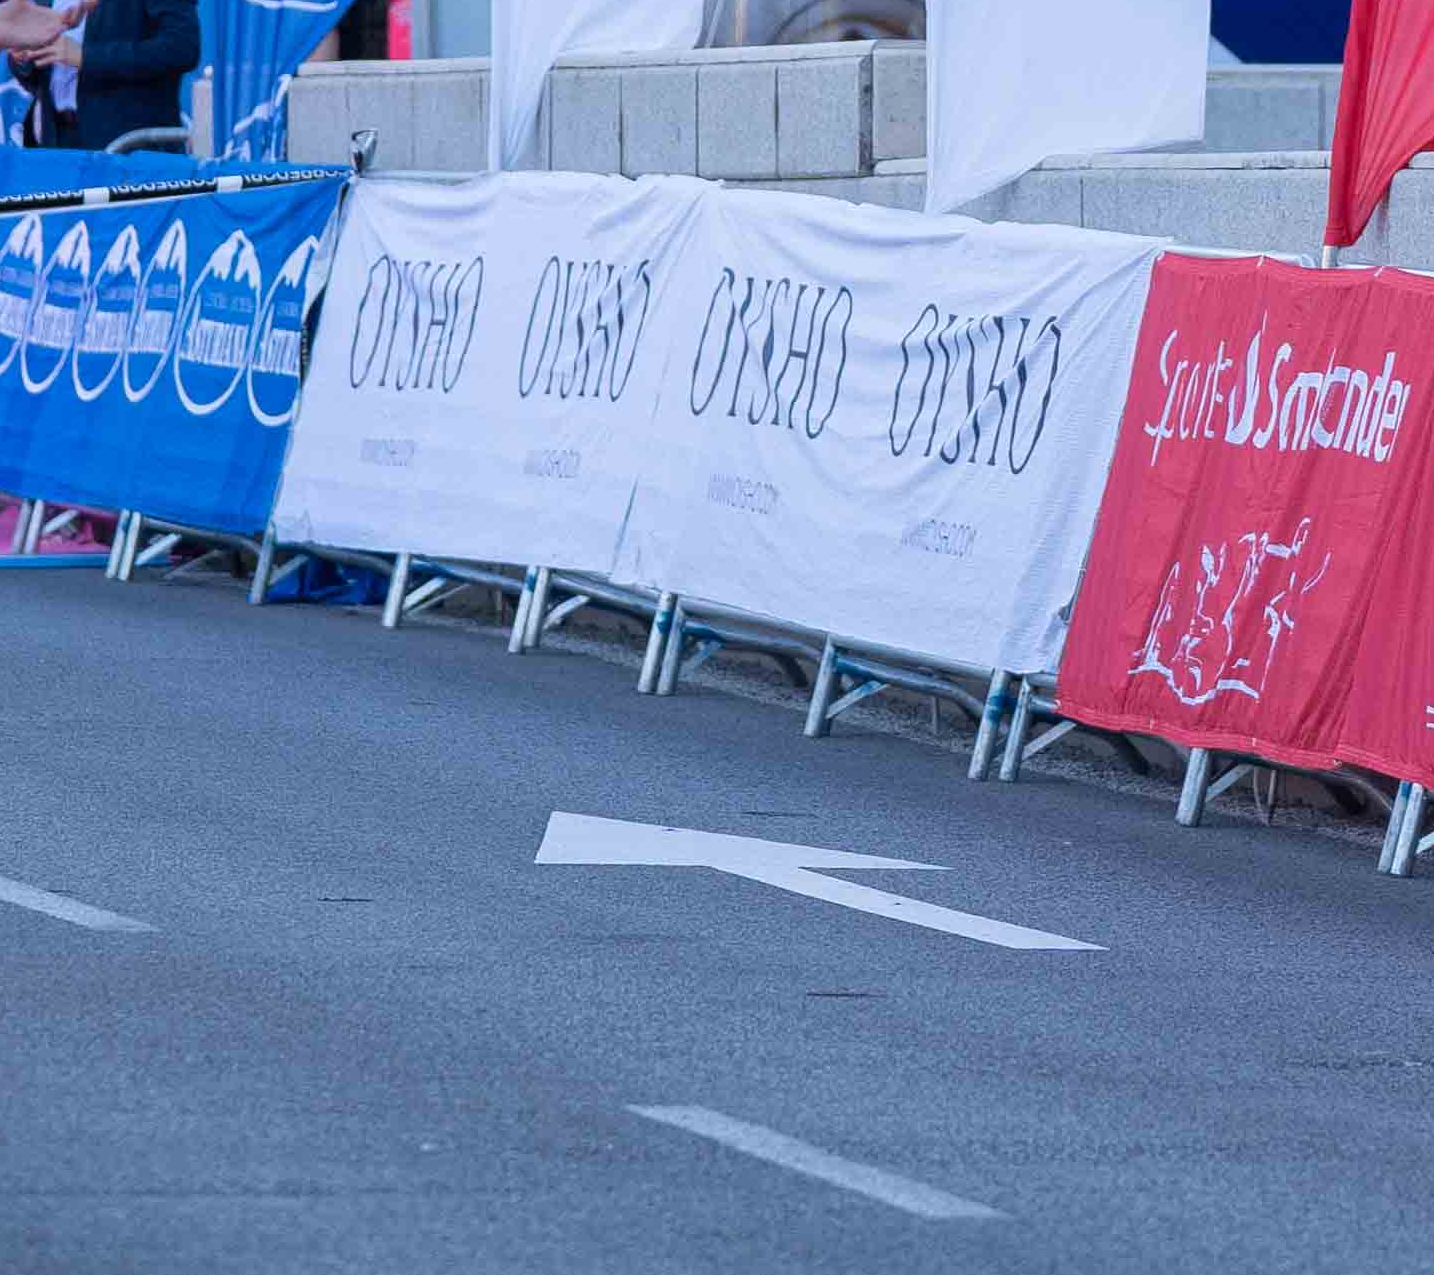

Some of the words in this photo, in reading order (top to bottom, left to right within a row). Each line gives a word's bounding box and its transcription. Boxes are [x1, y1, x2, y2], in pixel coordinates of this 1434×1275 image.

[350, 254, 484, 394] OYSHO
[519, 255, 652, 403] OYSHO
[689, 265, 854, 440] OYSHO
[889, 302, 1063, 476] OYSHO
